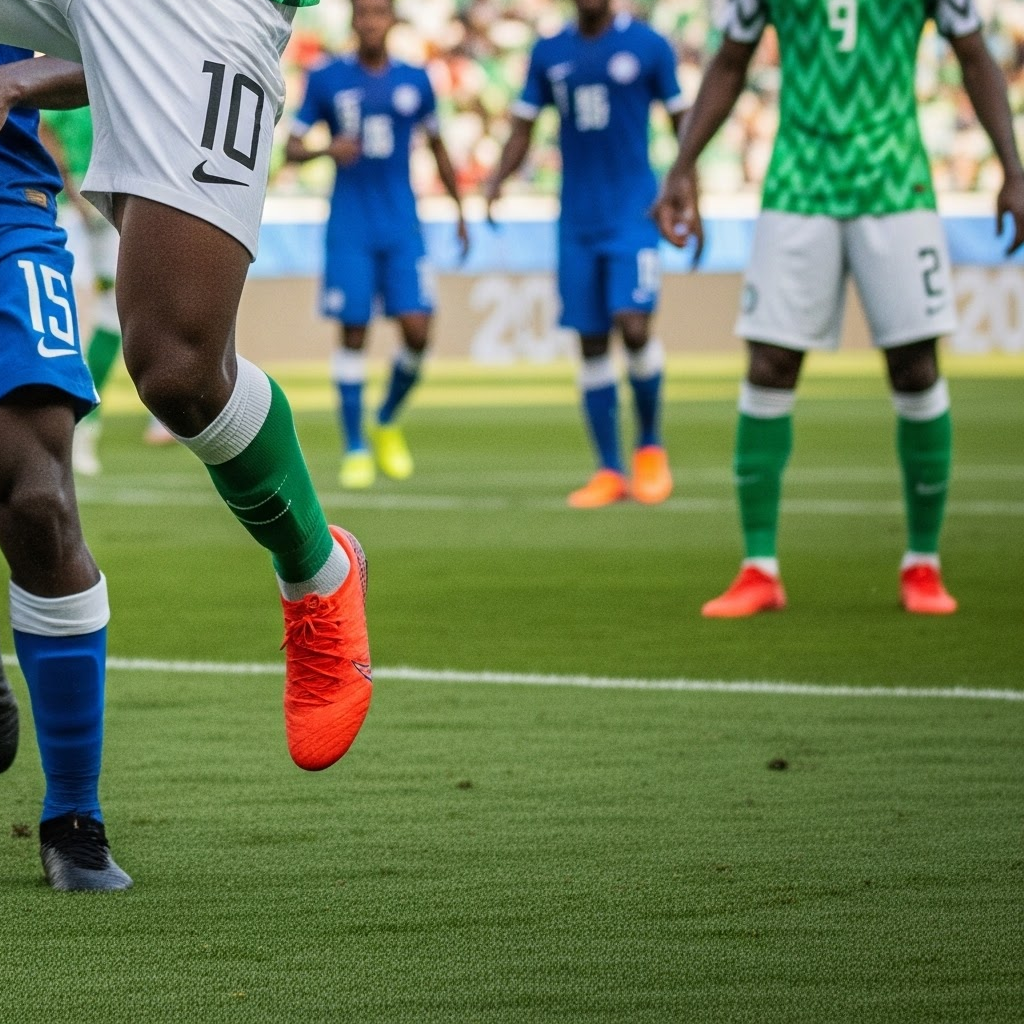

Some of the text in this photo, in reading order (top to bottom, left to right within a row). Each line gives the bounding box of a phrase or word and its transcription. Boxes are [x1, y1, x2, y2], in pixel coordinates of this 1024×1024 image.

[201, 60, 264, 171] 10
[17, 260, 74, 346] 15
[918, 247, 944, 296] 2
